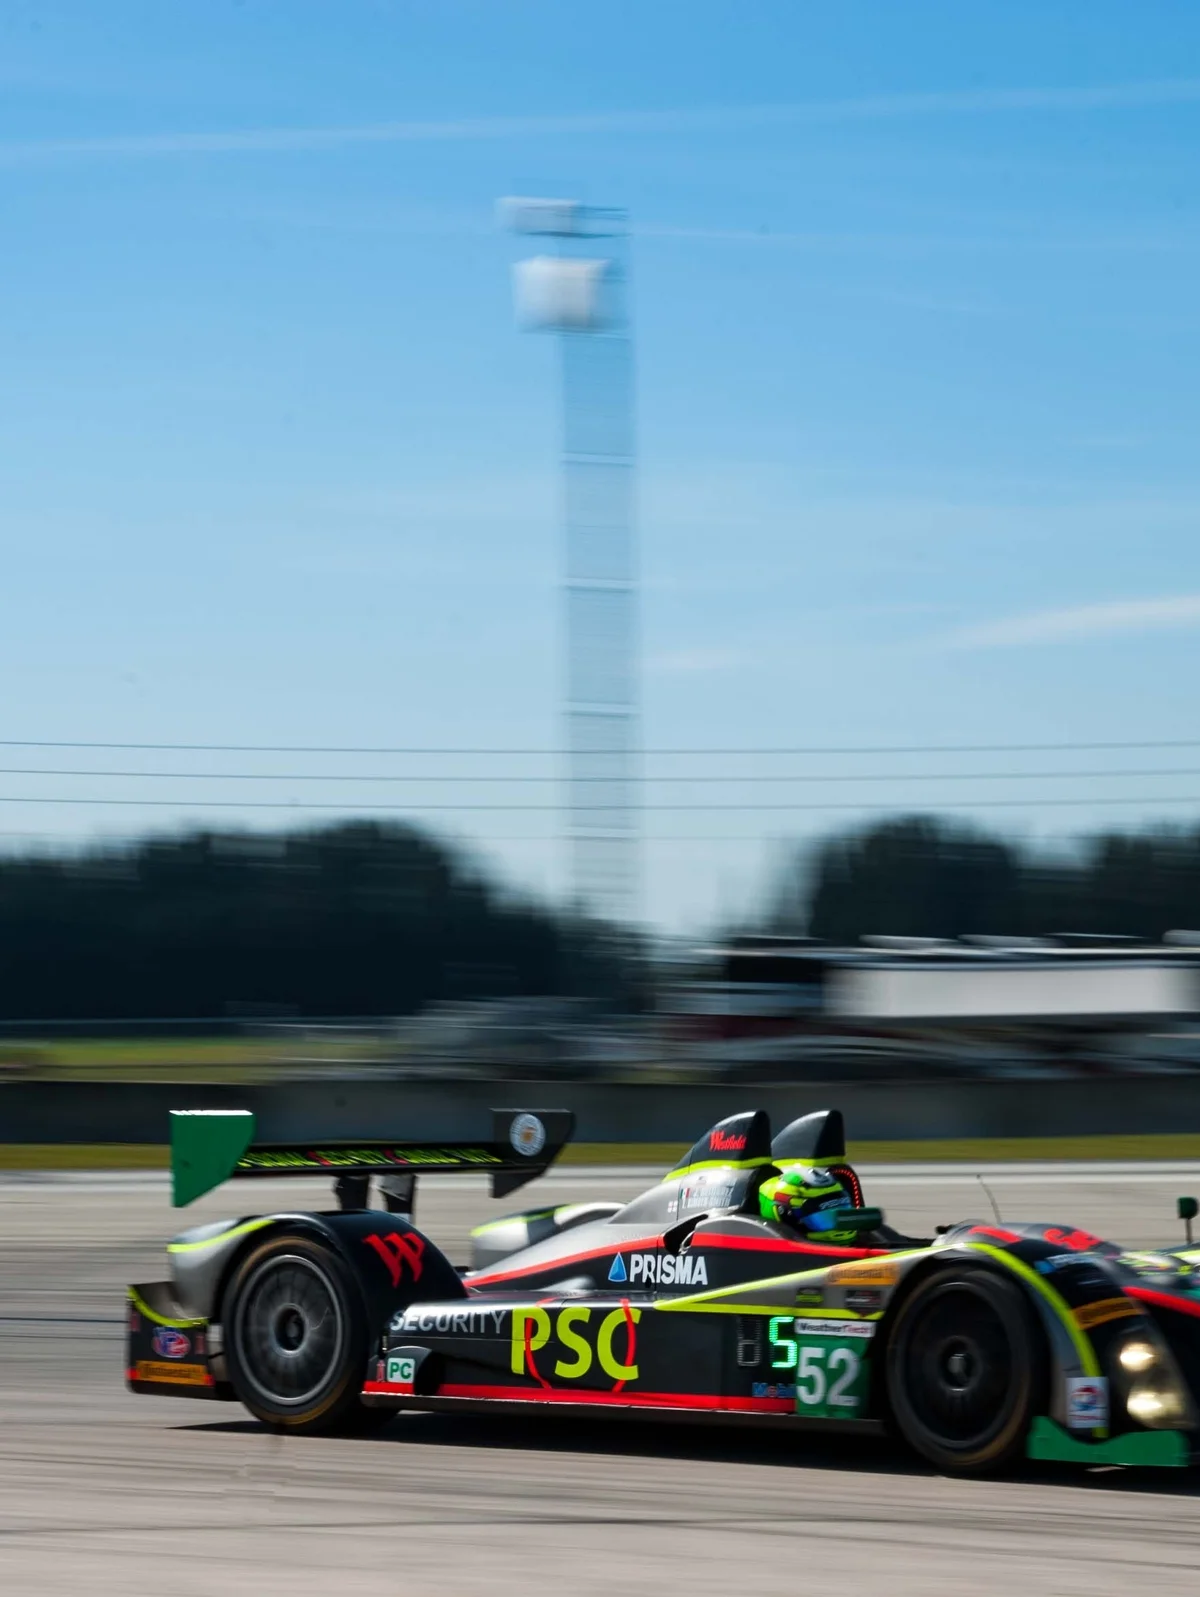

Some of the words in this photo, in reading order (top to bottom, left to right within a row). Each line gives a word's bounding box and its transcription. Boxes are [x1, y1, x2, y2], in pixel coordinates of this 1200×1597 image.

[629, 1254, 709, 1285] PRISMA
[390, 1310, 507, 1334] SECURITY
[511, 1306, 642, 1381] PSC
[390, 1361, 412, 1380] PC
[797, 1346, 861, 1407] 52
